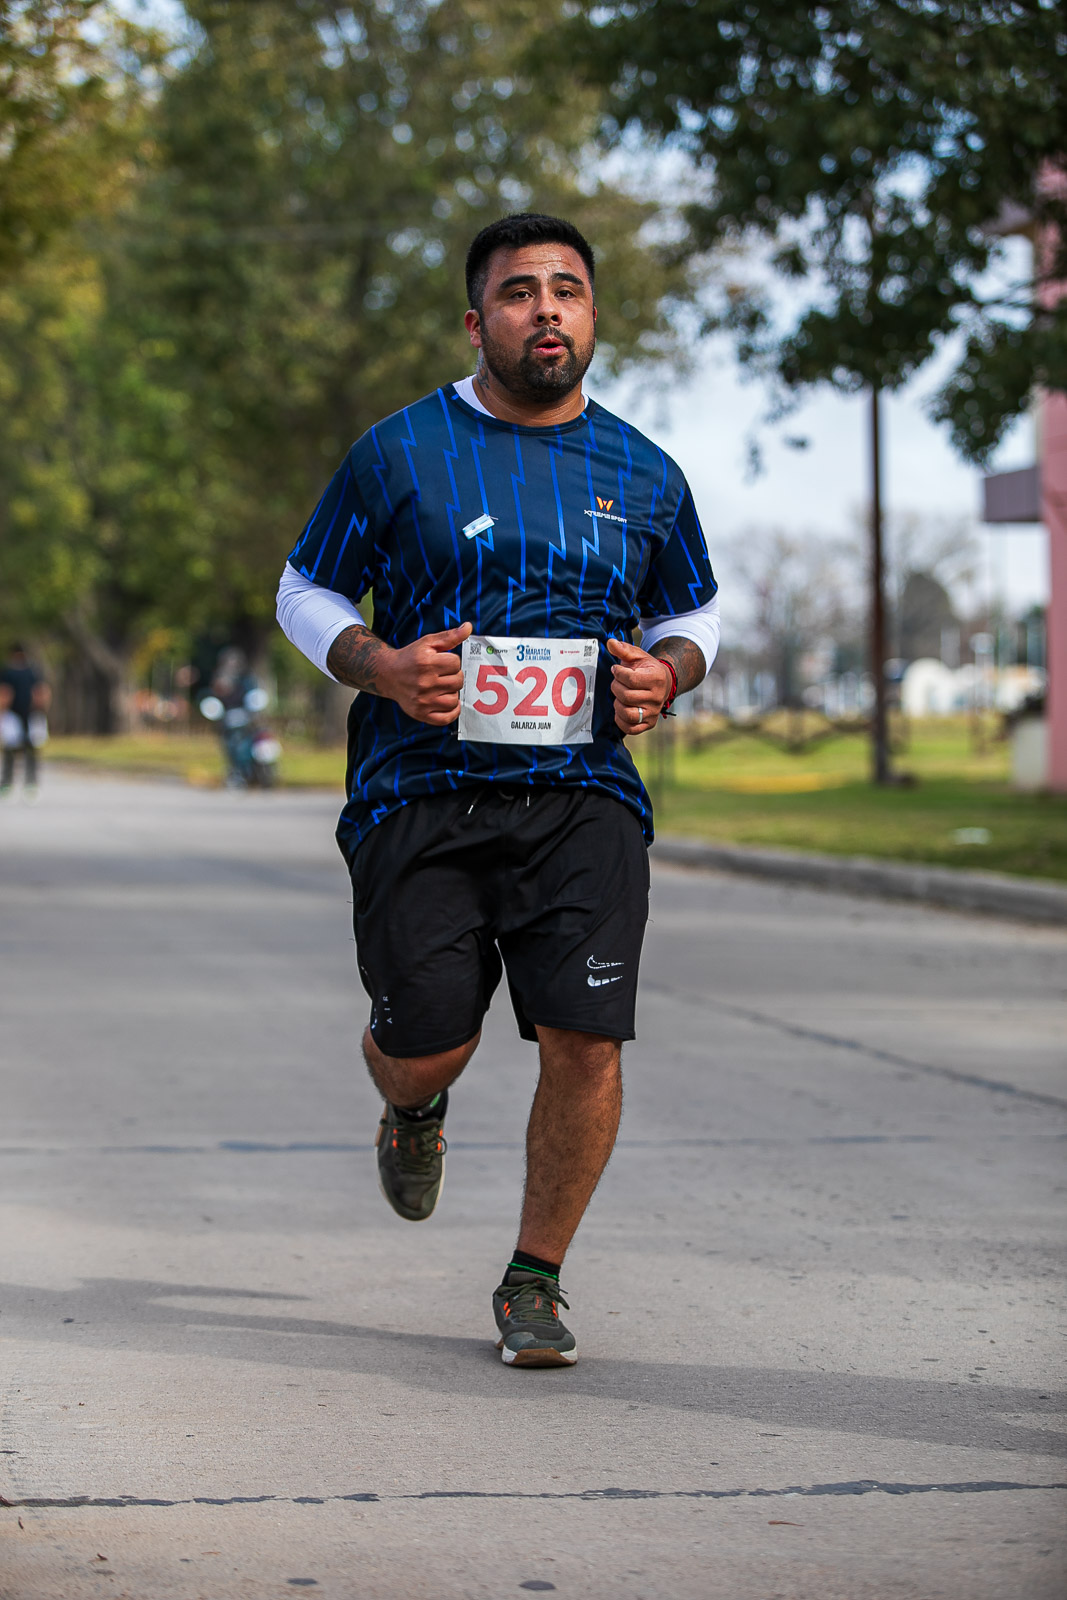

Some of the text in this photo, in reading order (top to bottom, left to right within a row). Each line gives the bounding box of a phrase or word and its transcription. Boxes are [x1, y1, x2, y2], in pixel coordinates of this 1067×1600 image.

[525, 647, 551, 656] MARATÓN
[472, 664, 587, 717] 520
[510, 720, 552, 730] GALARZA JUAN
